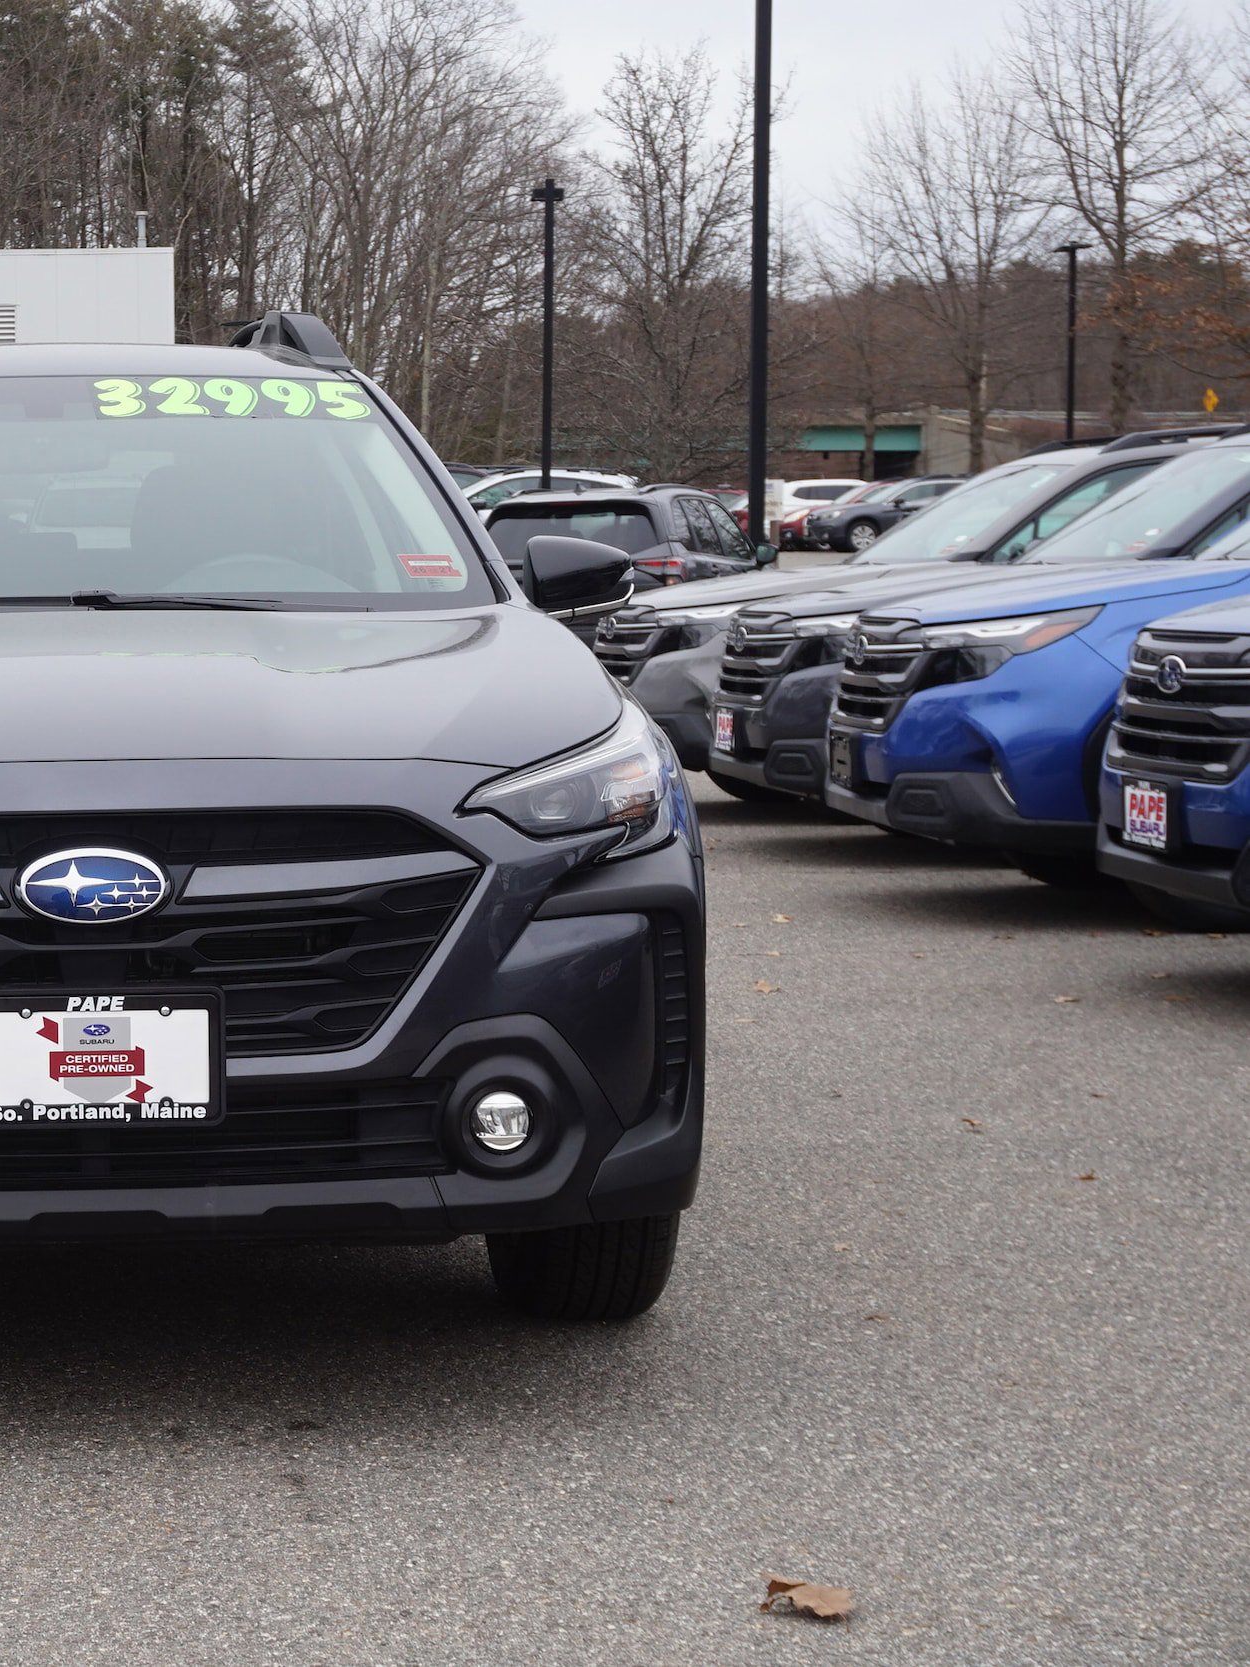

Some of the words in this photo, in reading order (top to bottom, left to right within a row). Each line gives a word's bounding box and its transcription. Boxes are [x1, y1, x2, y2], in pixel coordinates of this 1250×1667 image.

[94, 377, 371, 420] 32995
[1129, 792, 1165, 822] PAPE
[66, 996, 125, 1012] PAPE
[65, 1054, 129, 1064] CERTIFIED
[59, 1064, 135, 1073] PRE-OWNED
[32, 1104, 132, 1123] Portland,
[140, 1103, 207, 1120] Maine
